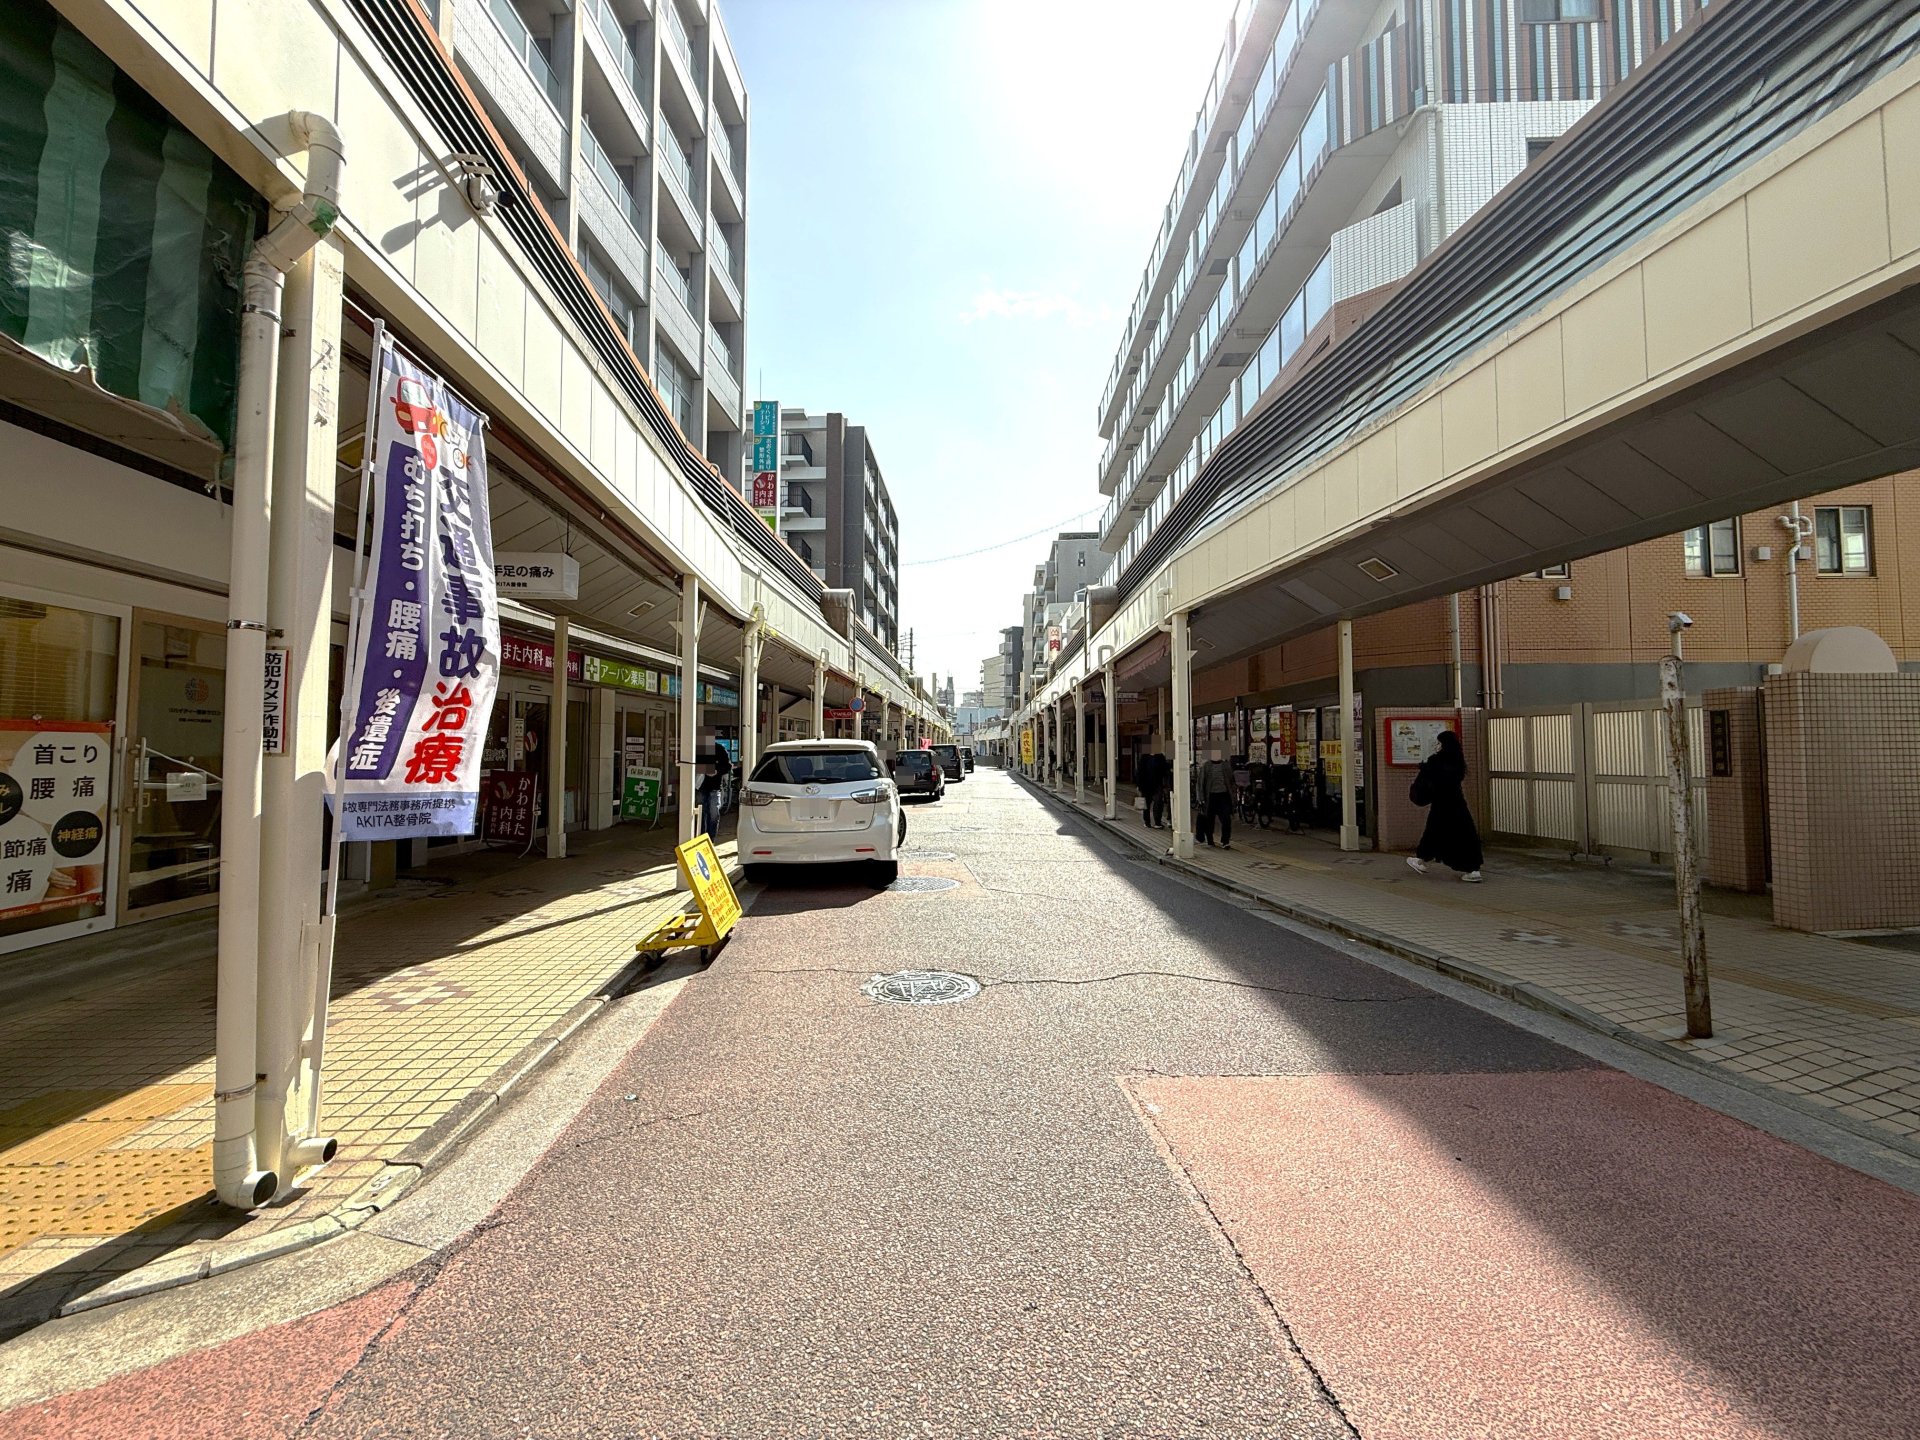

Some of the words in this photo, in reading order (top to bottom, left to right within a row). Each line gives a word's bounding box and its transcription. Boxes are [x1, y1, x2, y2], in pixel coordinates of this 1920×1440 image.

[759, 490, 766, 505] 内科
[404, 465, 489, 784] 交通事故治療
[1049, 639, 1061, 651] 肉
[263, 652, 283, 751] 防犯カメラ作動中
[33, 744, 98, 765] 首こり
[514, 777, 531, 836] かわまた
[357, 812, 432, 829] AKITA整骨院
[498, 806, 513, 836] 内科
[56, 827, 98, 843] 神経痛
[0, 836, 48, 859] 節痛
